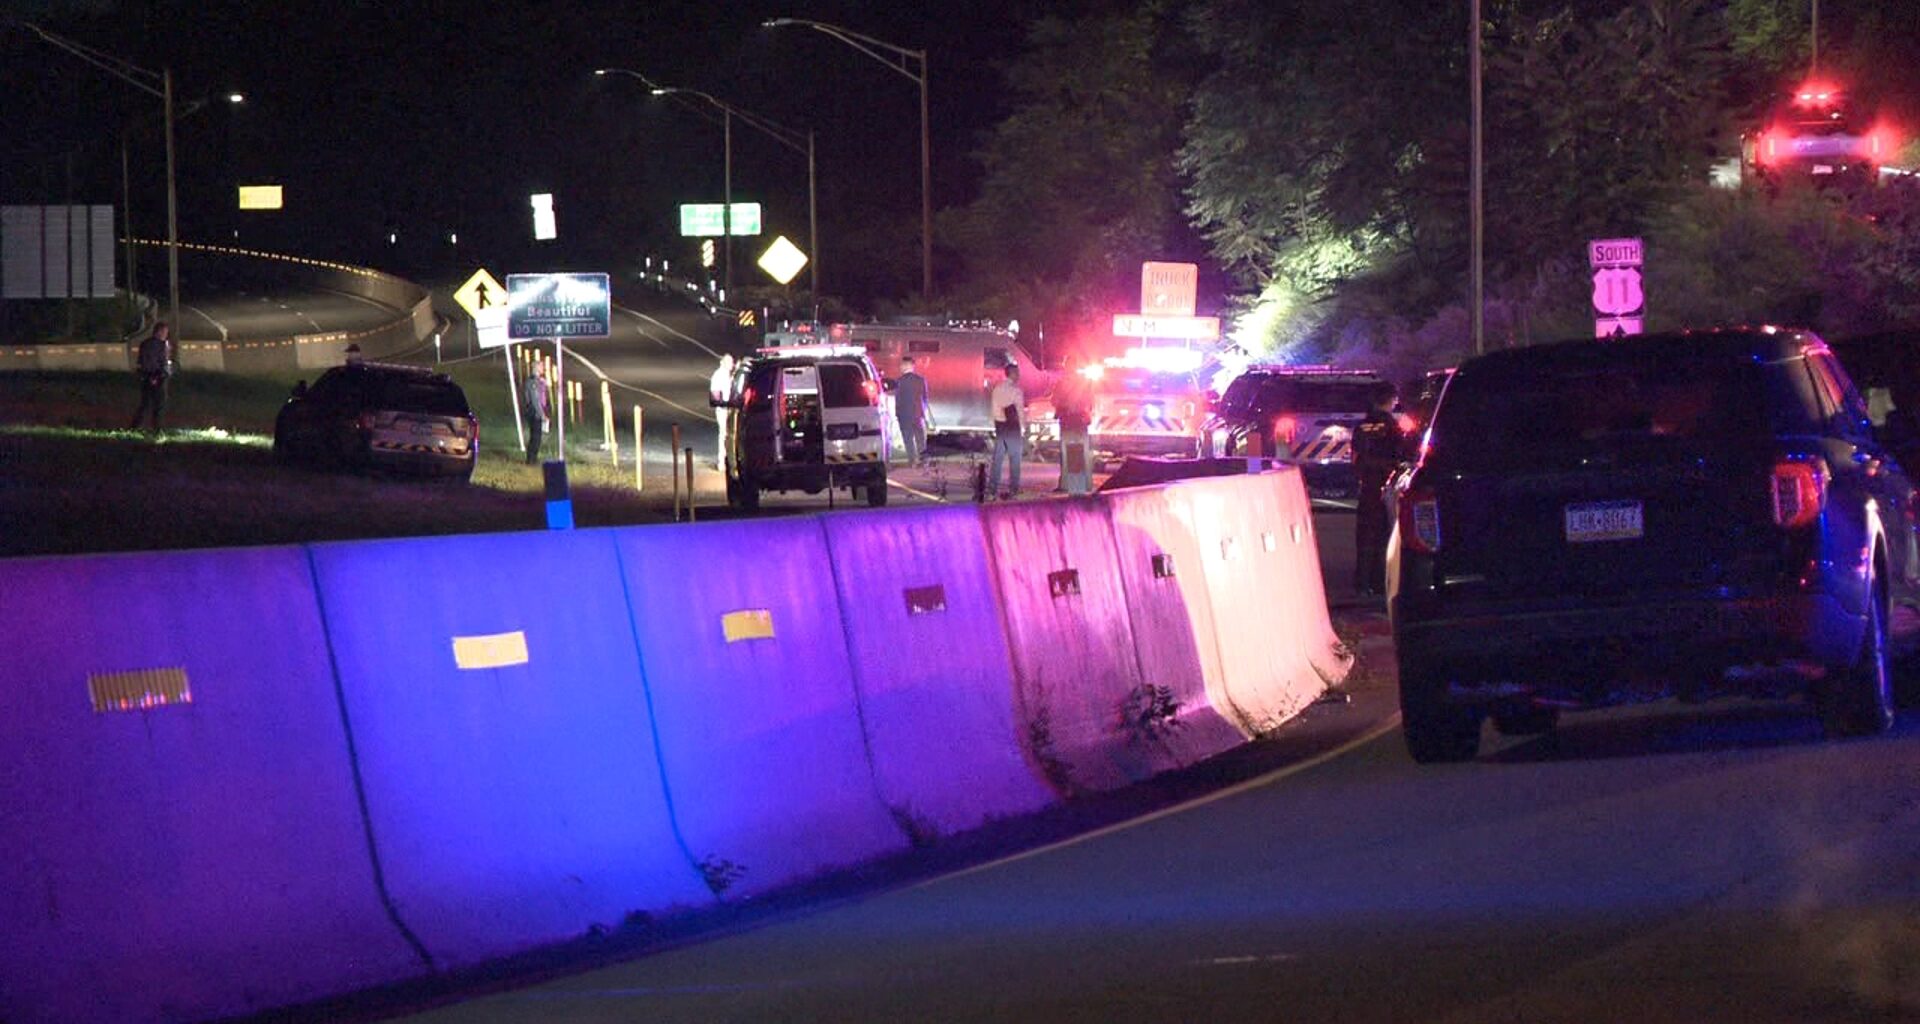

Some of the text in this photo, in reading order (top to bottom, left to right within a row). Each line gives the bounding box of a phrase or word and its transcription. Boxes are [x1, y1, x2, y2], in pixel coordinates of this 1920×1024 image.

[1596, 246, 1638, 262] SOUTH
[1606, 278, 1628, 305] 11
[528, 306, 591, 317] Beautiful
[515, 324, 531, 335] DO
[565, 322, 603, 334] LITTER
